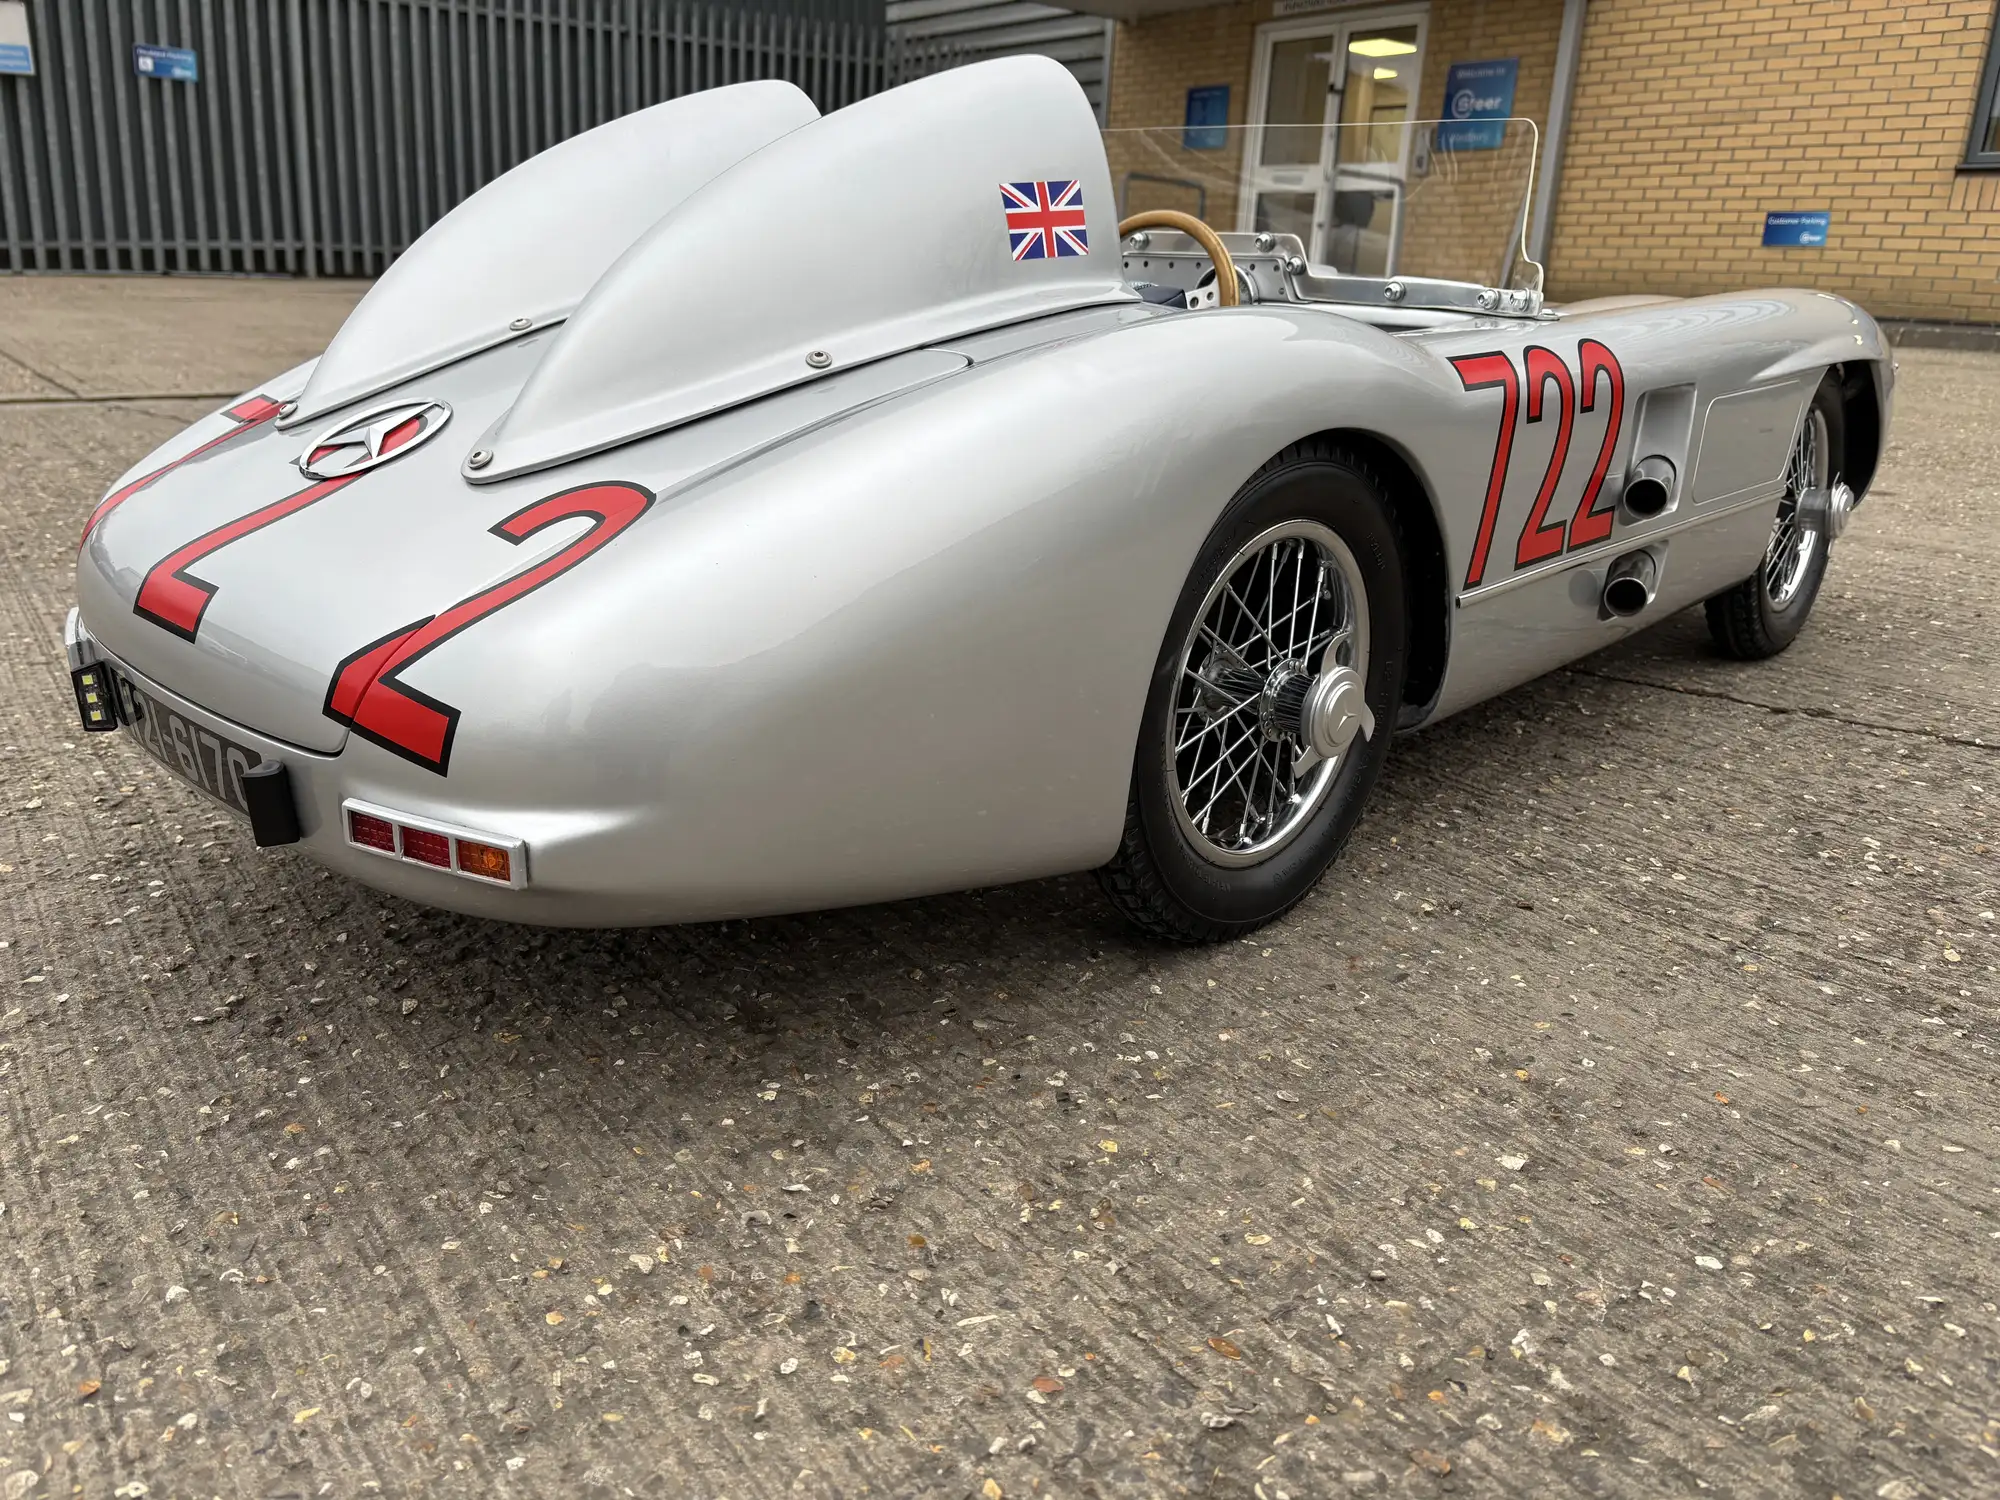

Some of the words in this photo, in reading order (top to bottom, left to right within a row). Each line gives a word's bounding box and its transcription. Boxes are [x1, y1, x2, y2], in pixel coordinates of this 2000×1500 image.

[1457, 68, 1494, 79] Welcome
[1767, 215, 1800, 226] Customer
[1801, 214, 1827, 226] Parking
[1446, 338, 1625, 591] 722
